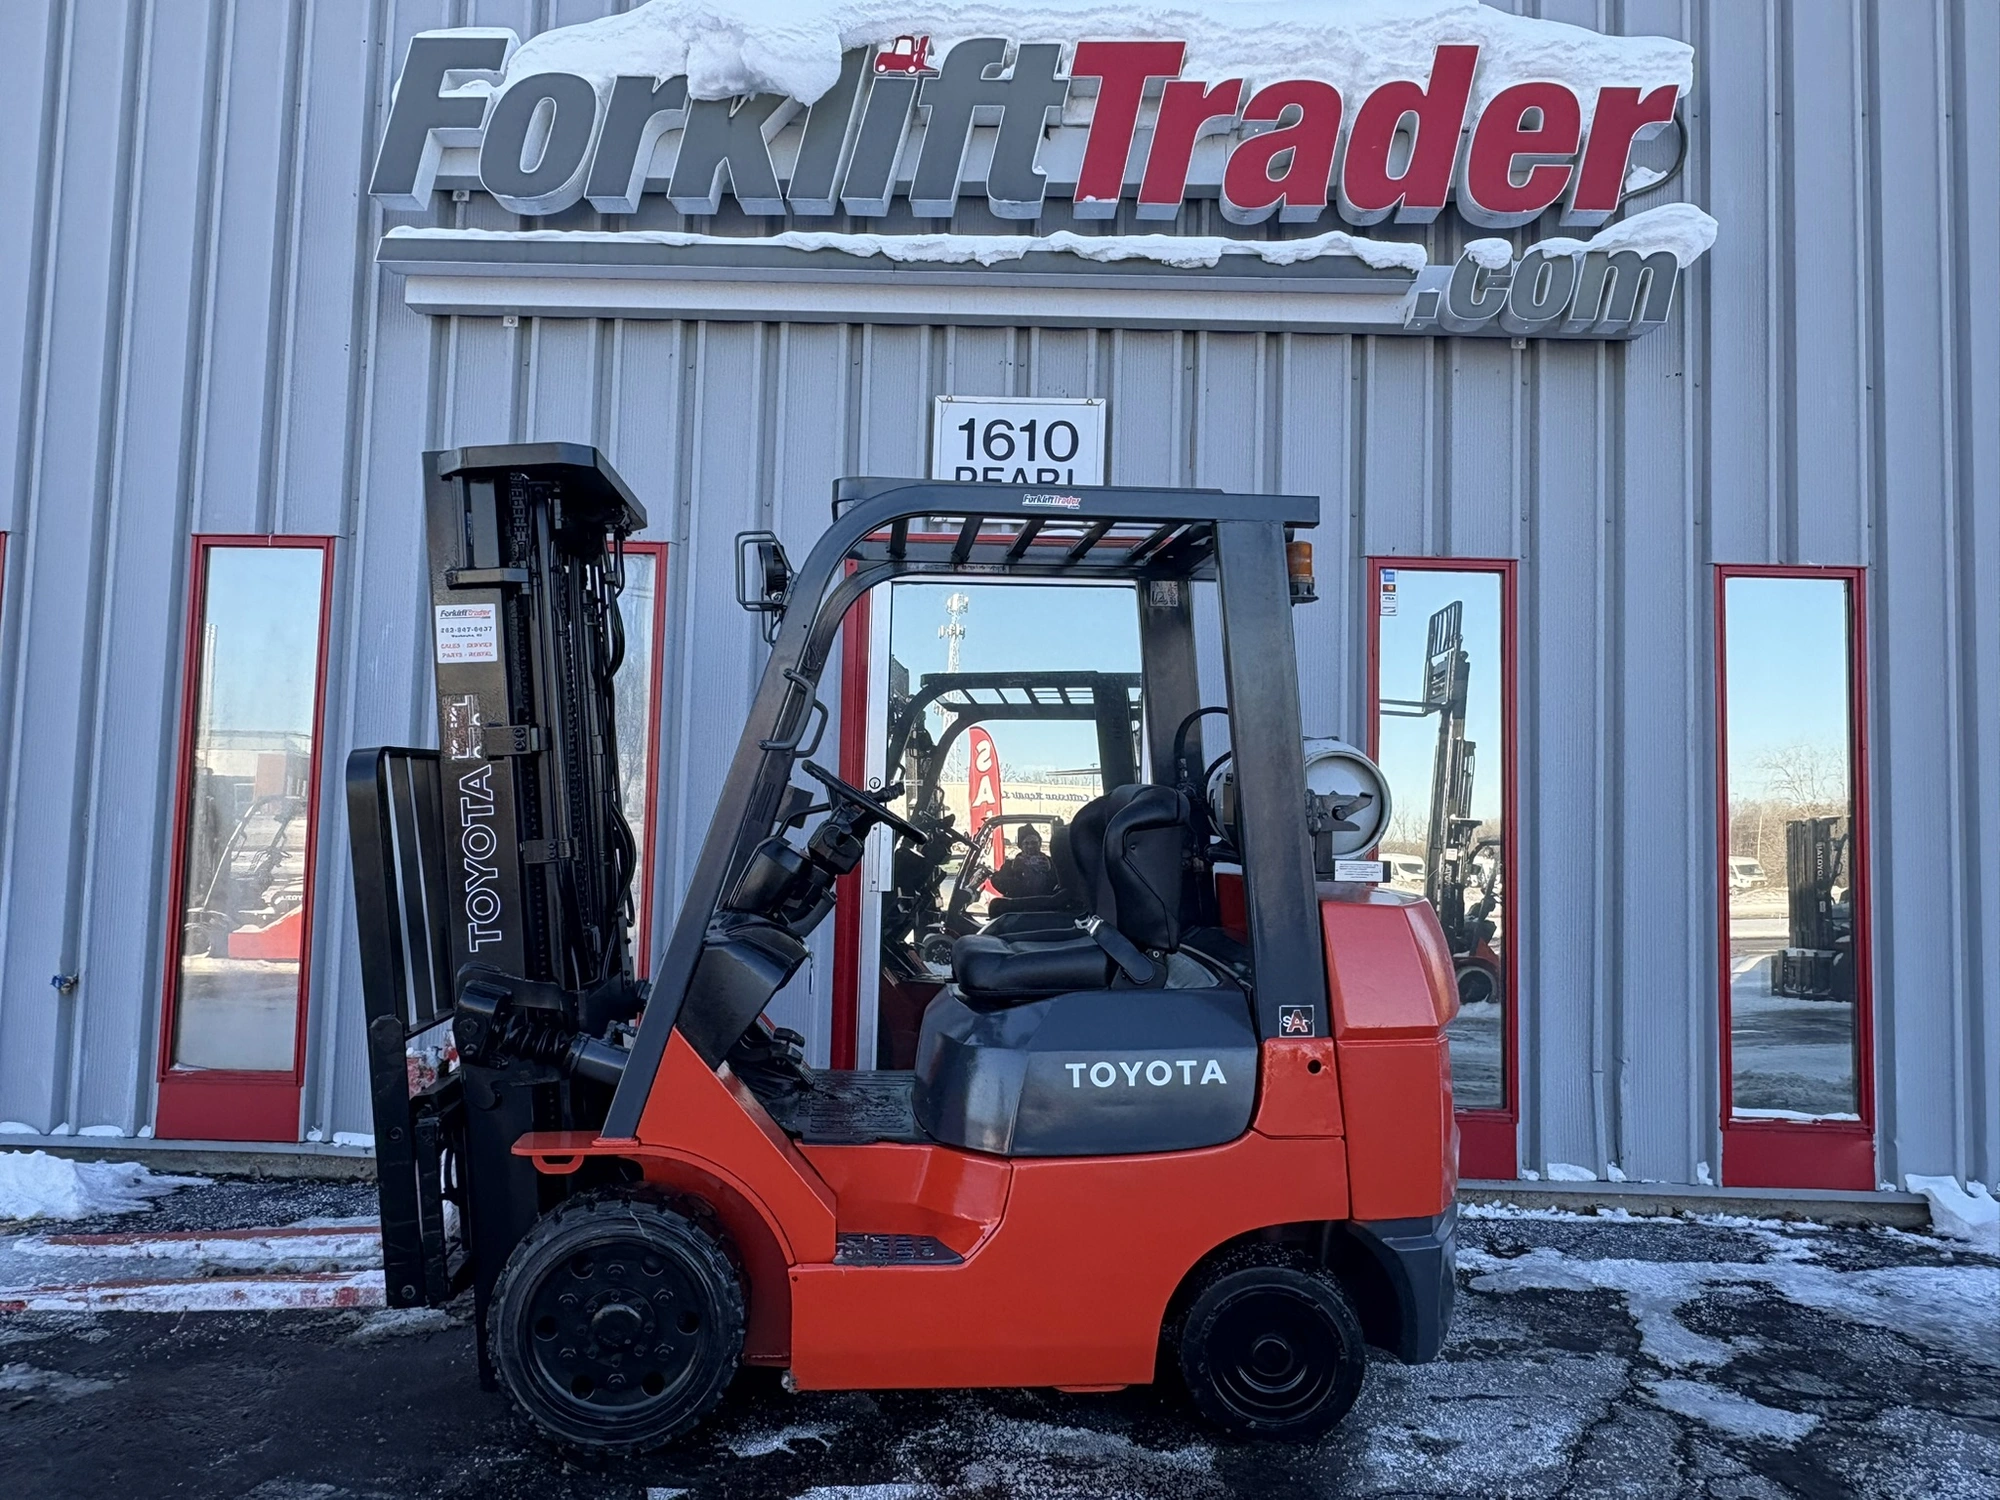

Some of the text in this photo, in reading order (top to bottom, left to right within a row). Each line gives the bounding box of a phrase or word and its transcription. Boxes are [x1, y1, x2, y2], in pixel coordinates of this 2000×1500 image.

[1411, 249, 1680, 328] .com
[958, 417, 1079, 462] 1610
[459, 764, 502, 953] TOYOTA
[1065, 1060, 1227, 1088] TOYOTA
